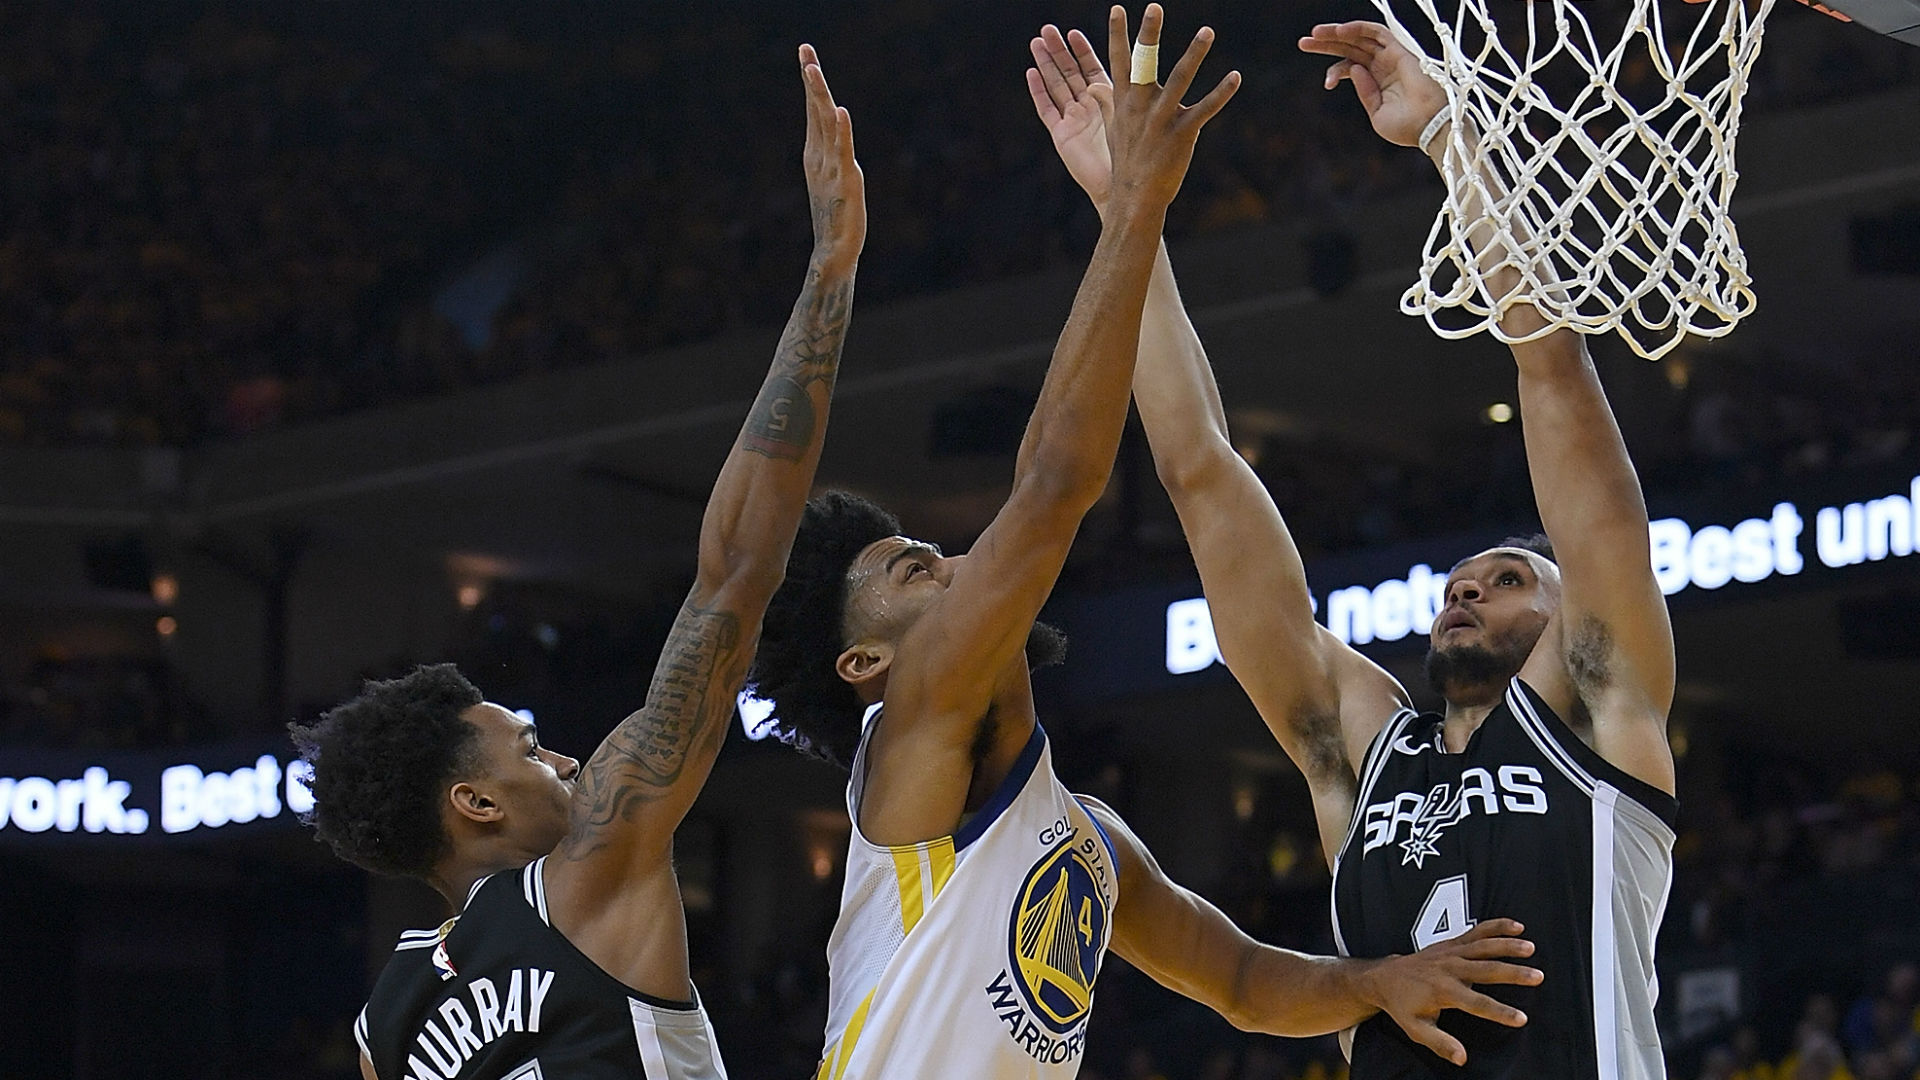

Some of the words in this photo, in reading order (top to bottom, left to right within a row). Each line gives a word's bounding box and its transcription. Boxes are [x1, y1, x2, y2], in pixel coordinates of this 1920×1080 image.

[1327, 564, 1448, 645] net
[1648, 502, 1804, 596] Best
[0, 766, 149, 834] ork.
[161, 754, 282, 834] Best
[1363, 765, 1549, 870] SPURS
[1078, 895, 1093, 948] 4
[1411, 873, 1478, 953] 4
